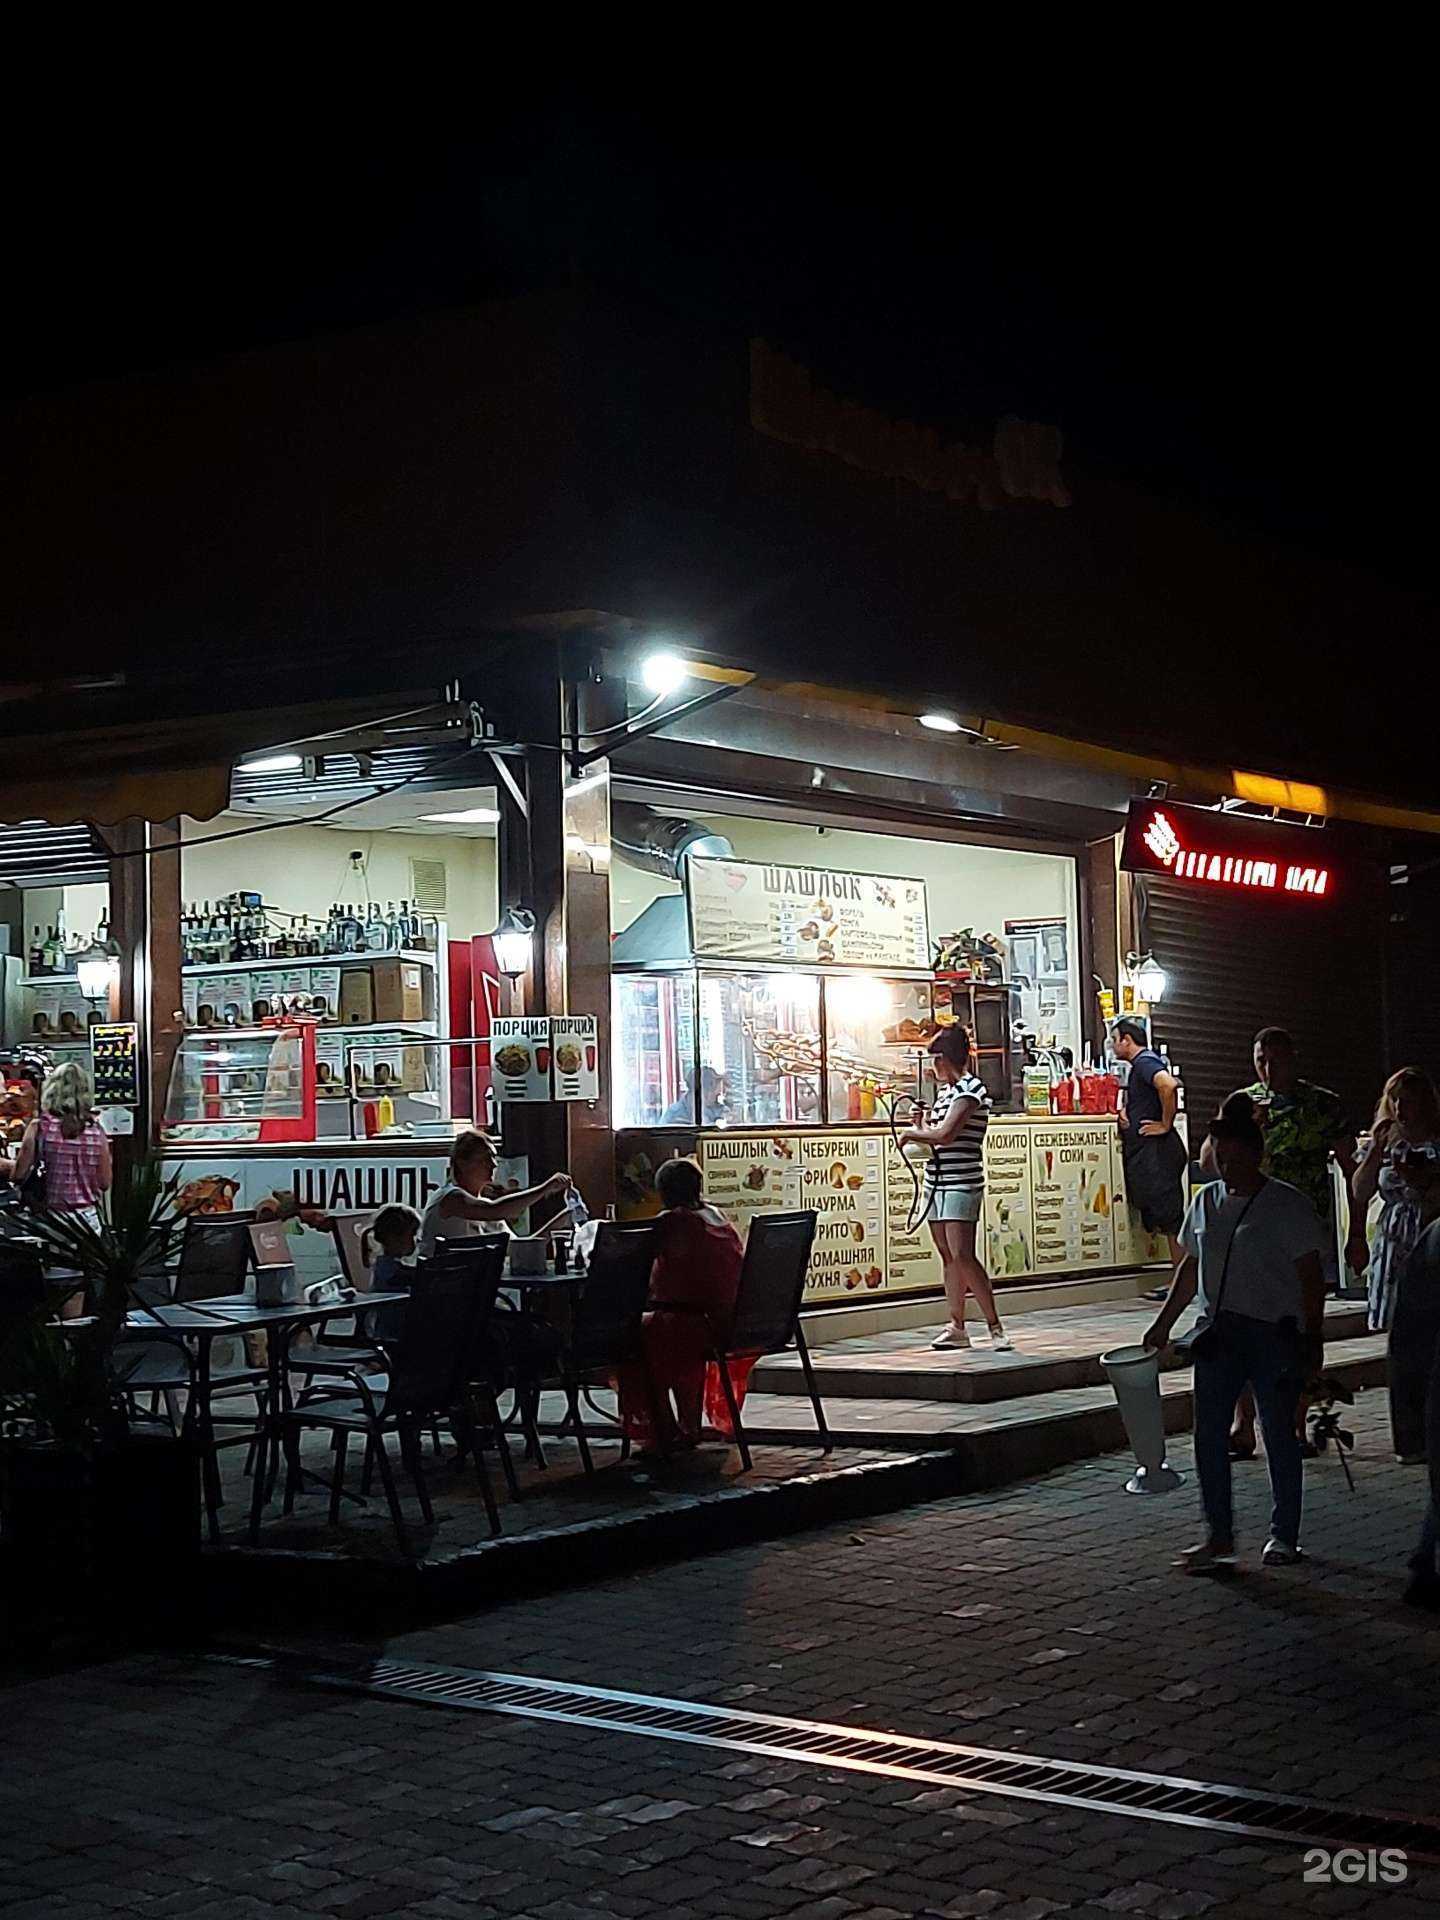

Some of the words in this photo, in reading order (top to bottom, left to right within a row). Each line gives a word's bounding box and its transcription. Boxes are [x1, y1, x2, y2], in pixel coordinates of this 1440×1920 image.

[763, 868, 861, 900] ШАШЛЫК
[493, 1020, 548, 1039] ПОРЦИЯ
[553, 1018, 595, 1036] ПОРЦИЯ
[986, 1134, 1028, 1149] МОХИТО
[1033, 1132, 1108, 1148] СВЕЖЕВЫЖАТЫЕ
[706, 1142, 769, 1160] ШАШЛЫК
[802, 1140, 860, 1159] ЧЕБУРЕКИ
[1059, 1149, 1084, 1163] СОКИ
[803, 1169, 829, 1185] ФРИ
[803, 1195, 857, 1213] ШАУРМА
[815, 1222, 849, 1240] РИТО
